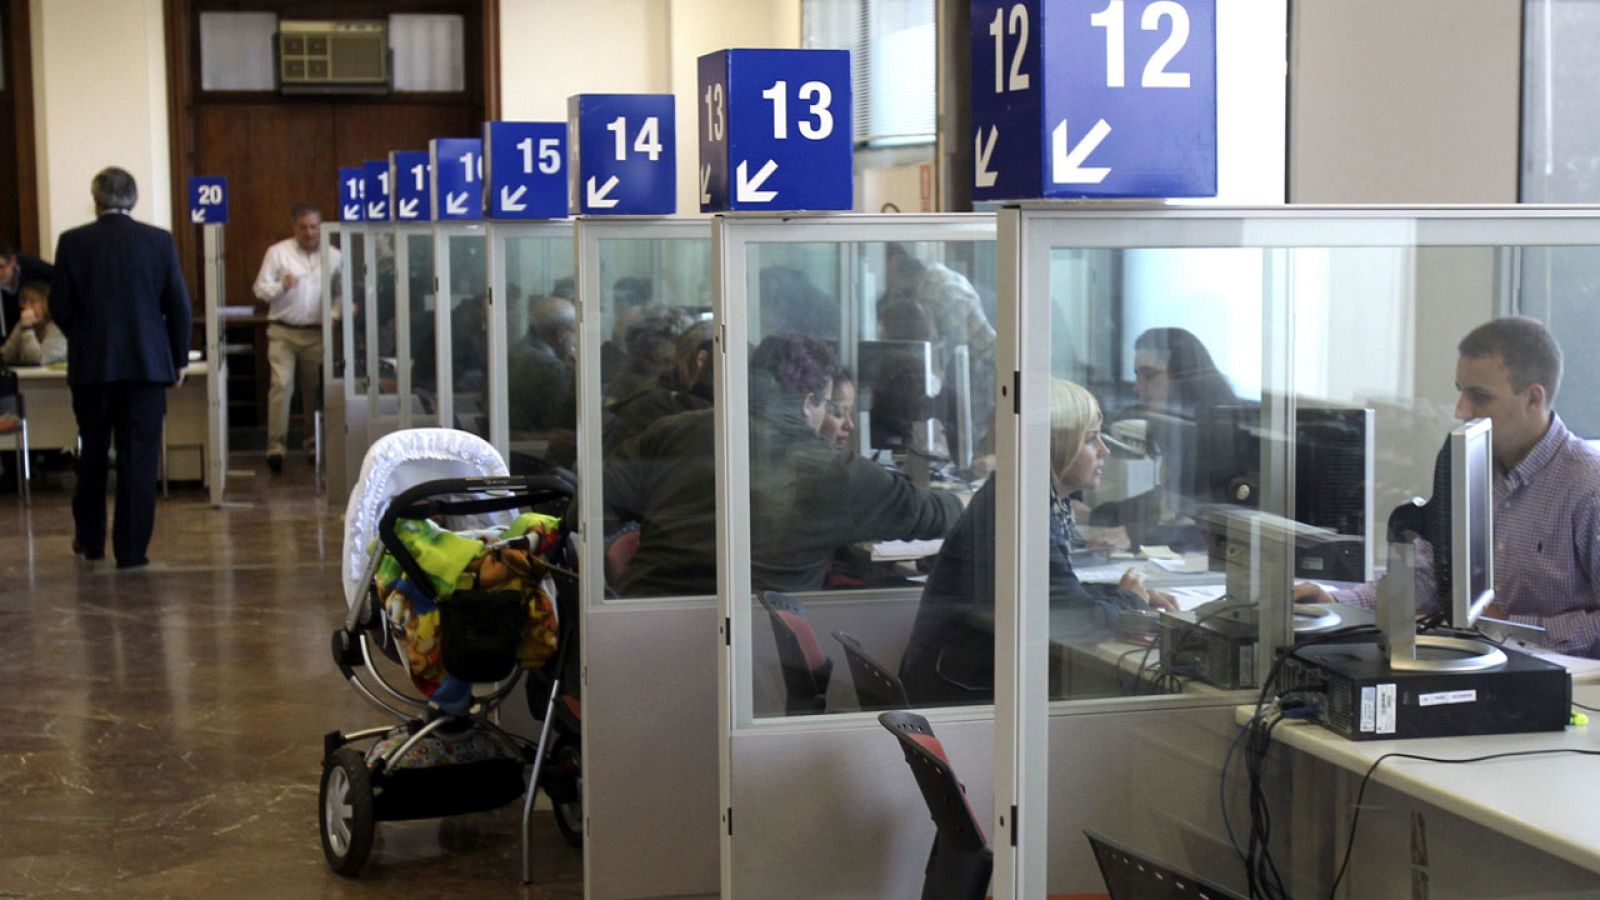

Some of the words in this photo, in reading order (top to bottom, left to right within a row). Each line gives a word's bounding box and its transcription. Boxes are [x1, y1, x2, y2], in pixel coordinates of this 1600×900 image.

[990, 4, 1029, 93] 12
[1091, 0, 1190, 88] 12
[706, 84, 723, 142] 13
[763, 81, 833, 140] 13
[517, 138, 561, 174] 15
[607, 117, 662, 160] 14
[411, 164, 431, 190] 1
[460, 153, 482, 182] 1
[198, 185, 222, 205] 20
